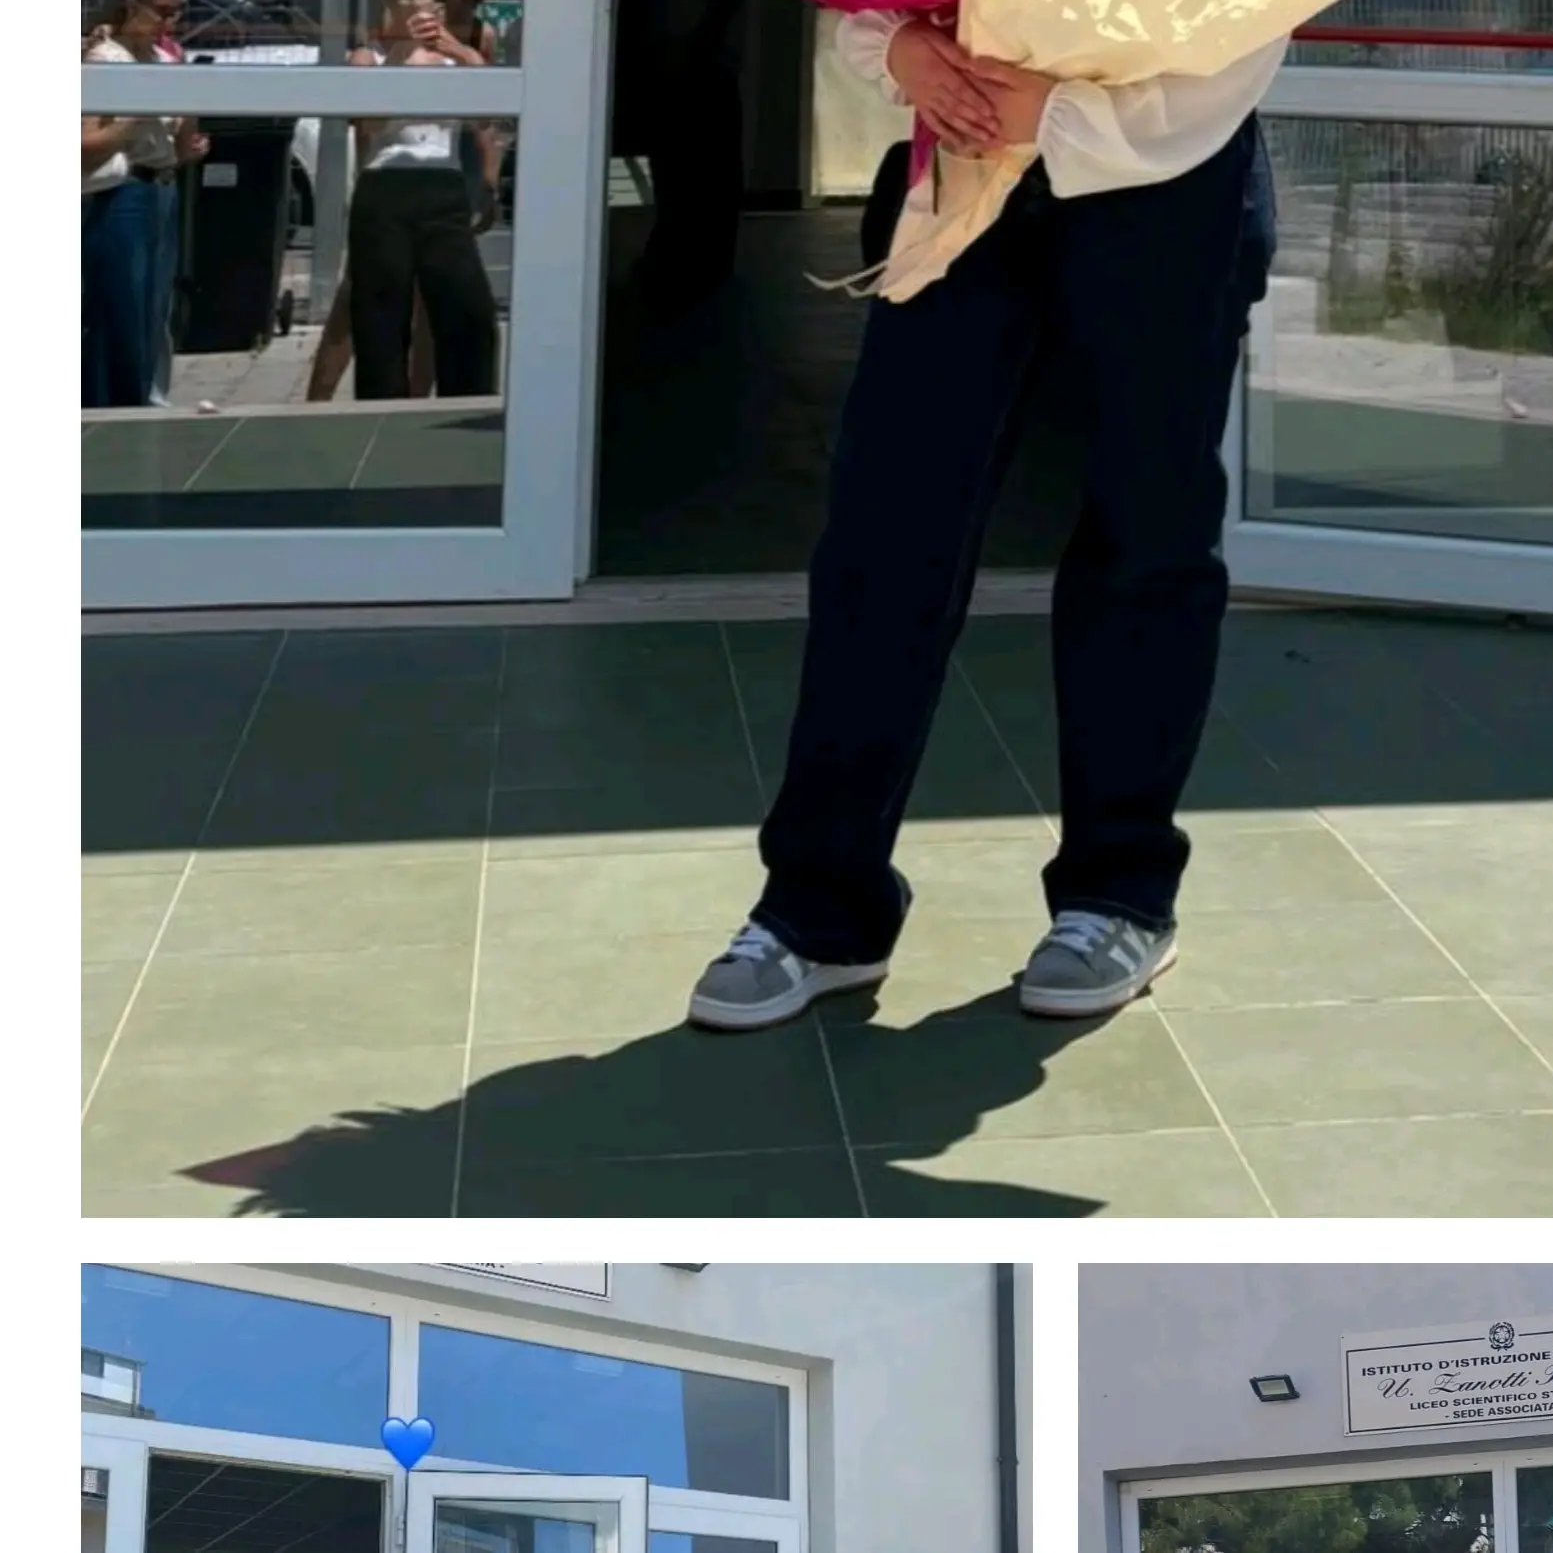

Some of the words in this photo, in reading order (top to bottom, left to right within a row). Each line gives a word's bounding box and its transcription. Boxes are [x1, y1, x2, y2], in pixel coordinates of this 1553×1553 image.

[1361, 1361, 1433, 1377] ISTITUTO
[1439, 1351, 1551, 1369] D'ISTRUZIONE
[1378, 1378, 1414, 1399] U.
[1431, 1373, 1532, 1395] Zanotti
[1409, 1399, 1449, 1411] LICEO
[1453, 1393, 1538, 1407] SCIENTIFICO
[1452, 1408, 1485, 1419] SEDE
